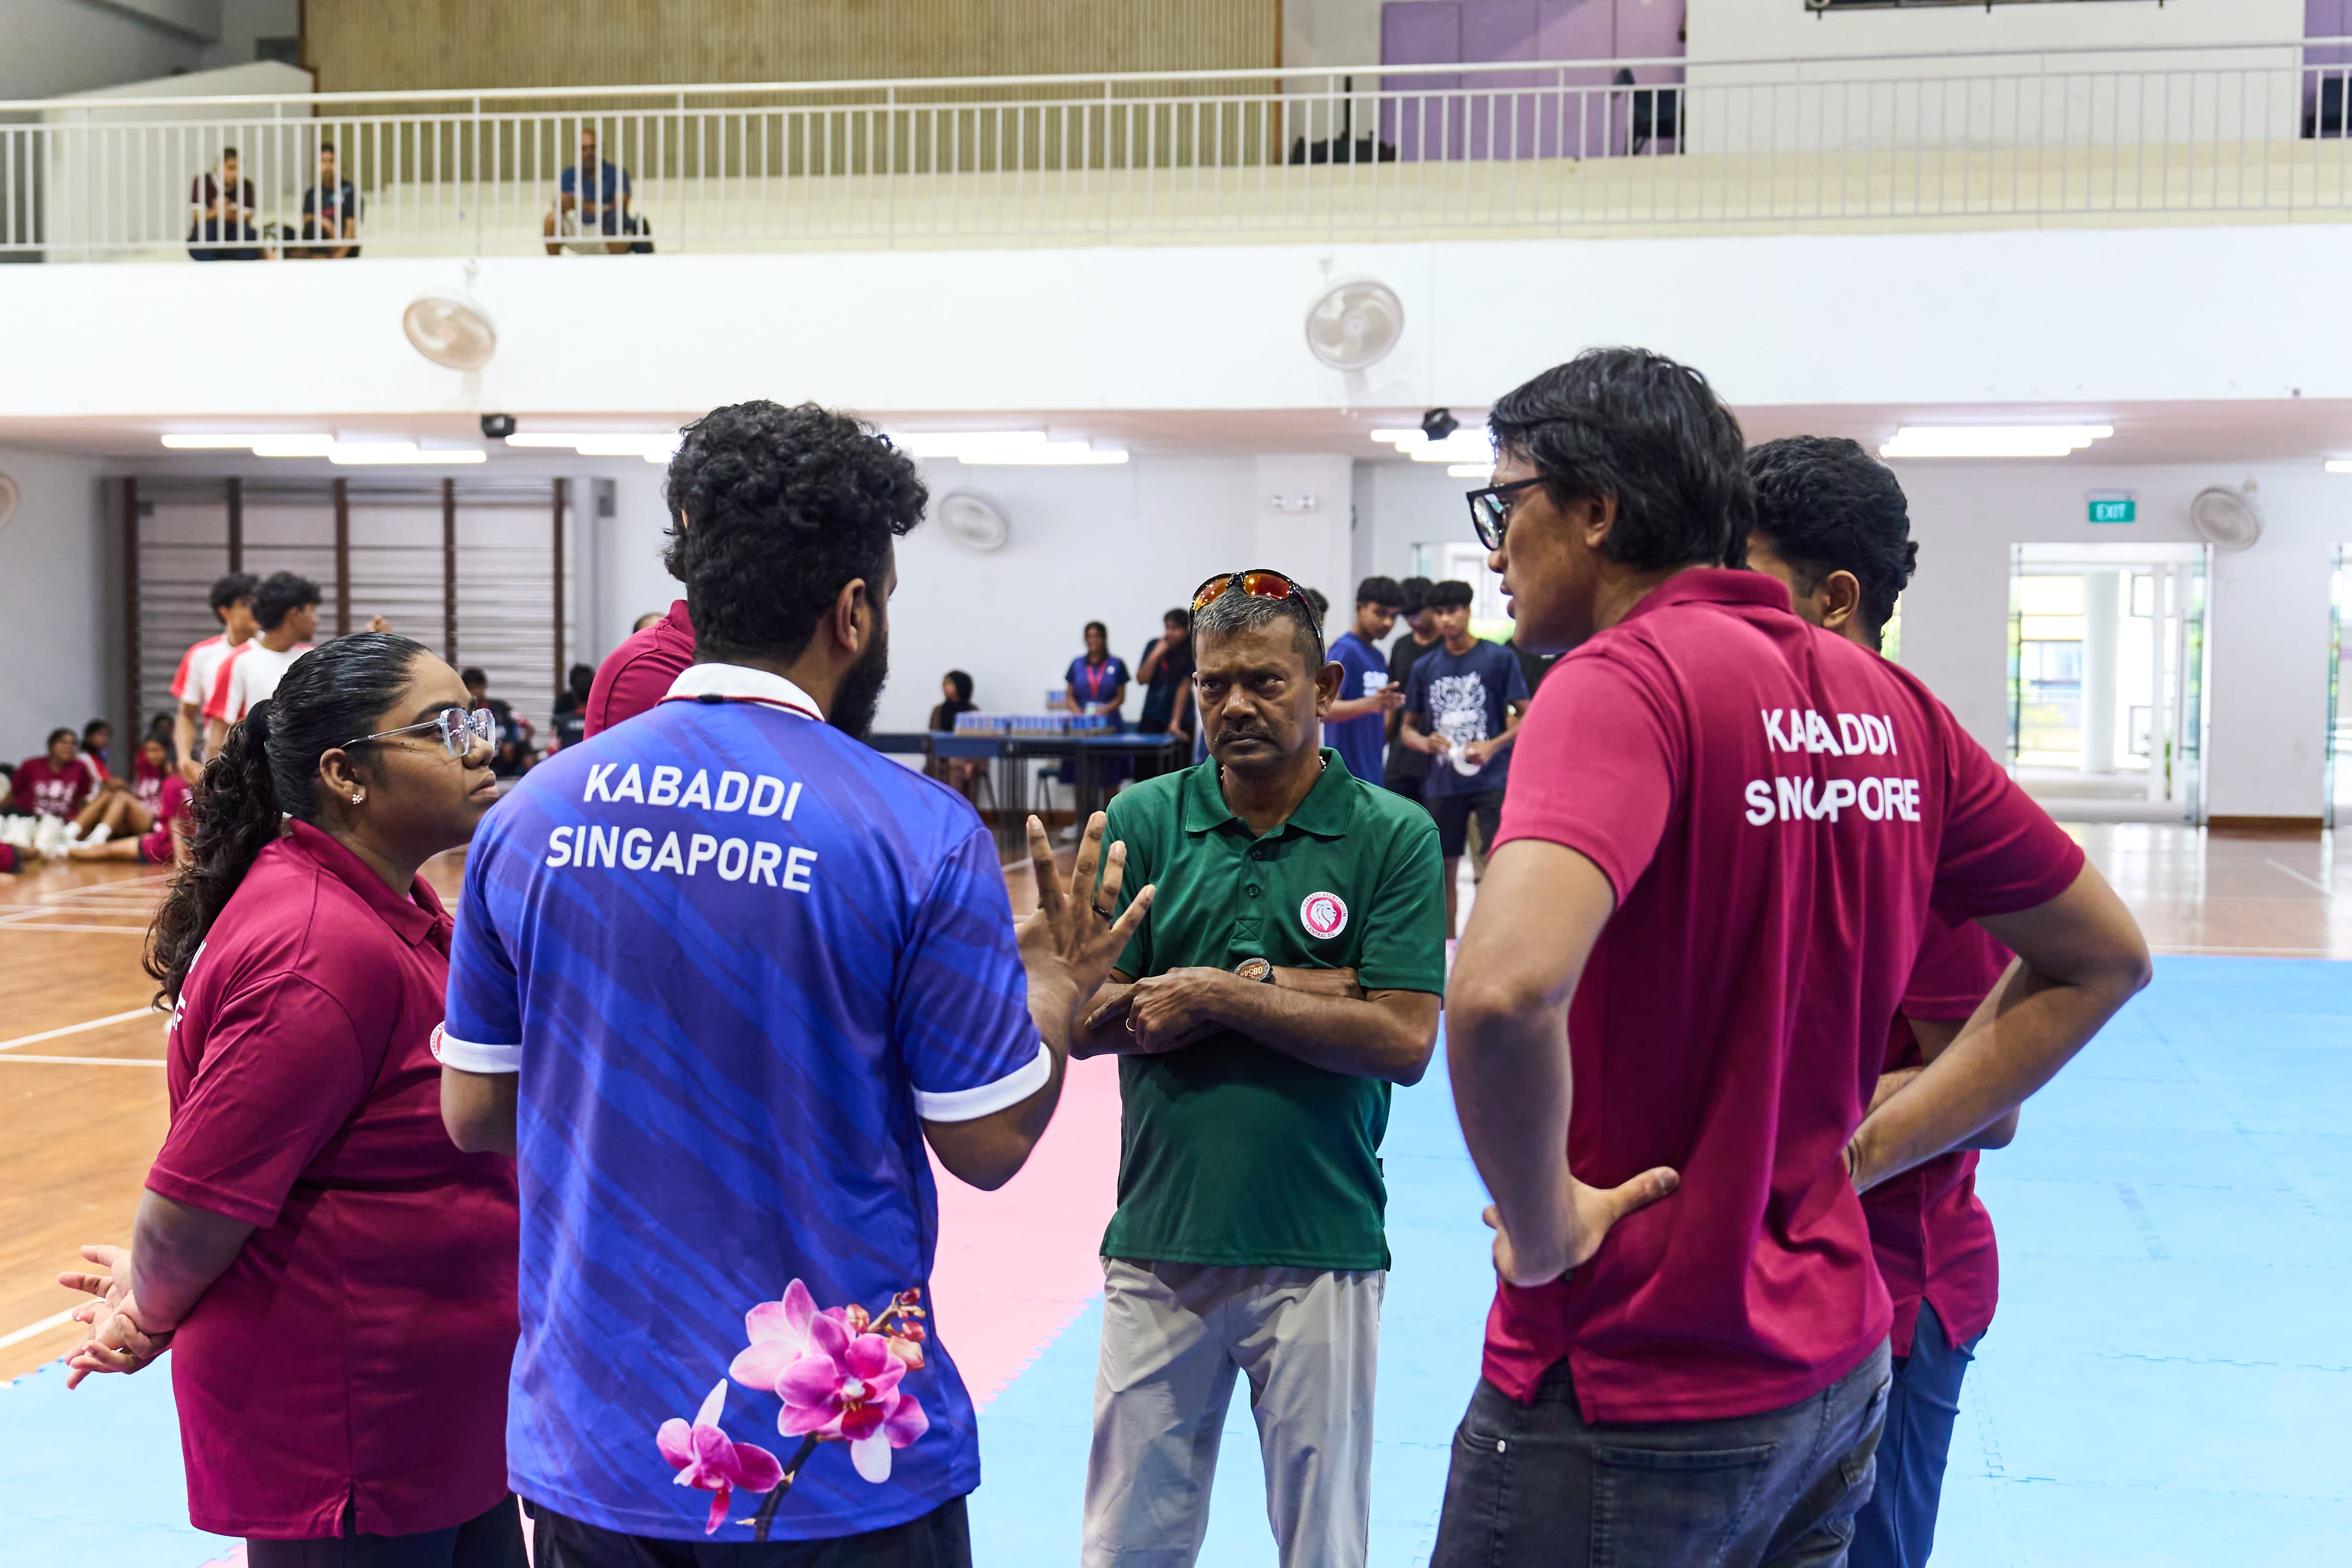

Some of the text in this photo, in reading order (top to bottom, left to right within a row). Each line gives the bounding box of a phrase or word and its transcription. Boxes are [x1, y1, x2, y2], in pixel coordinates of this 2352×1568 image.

[2096, 503, 2126, 521] EXIT
[583, 763, 803, 821] KABADDI
[545, 826, 818, 892] SINGAPORE
[1303, 893, 1347, 917] KABADDI ASSOCIATION
[1306, 924, 1326, 938] CENTRAL
